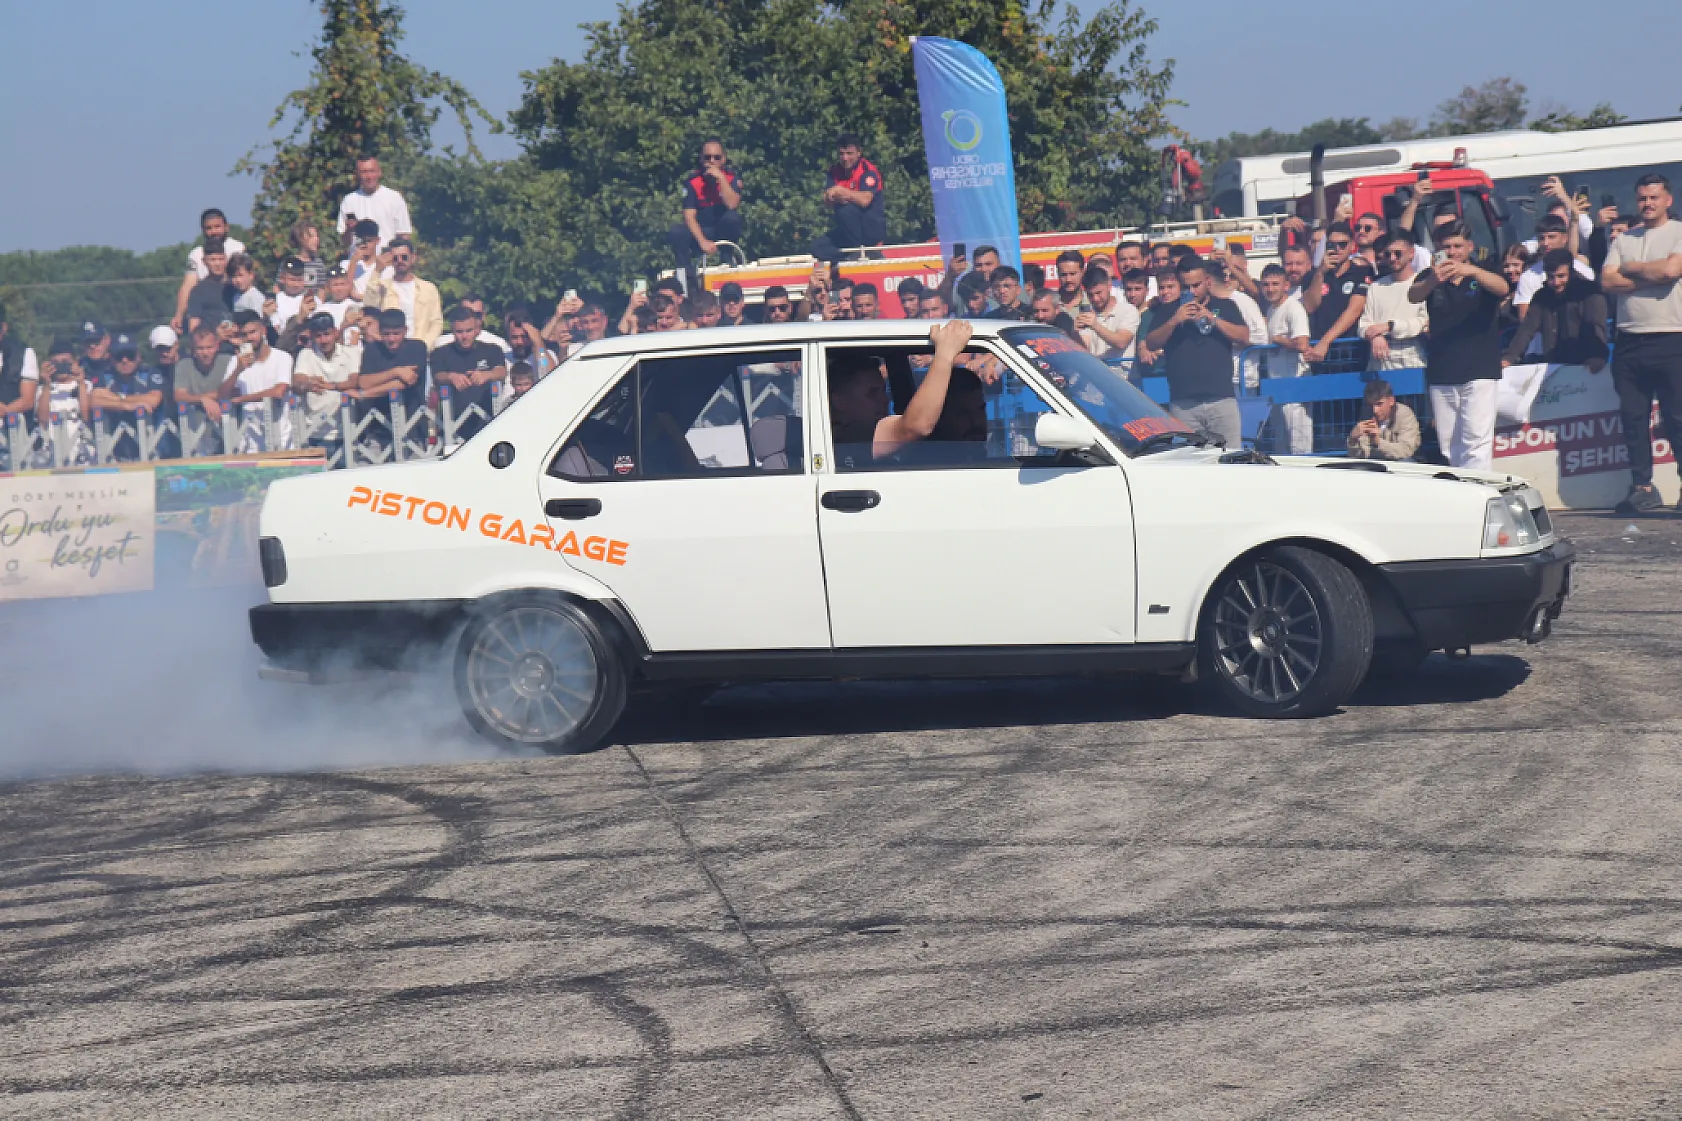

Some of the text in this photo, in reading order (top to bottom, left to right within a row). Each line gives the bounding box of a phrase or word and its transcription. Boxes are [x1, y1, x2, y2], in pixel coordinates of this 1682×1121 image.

[1494, 419, 1595, 452] SPORUN
[1565, 444, 1630, 473] ŞEHR
[479, 512, 631, 567] GARAGE
